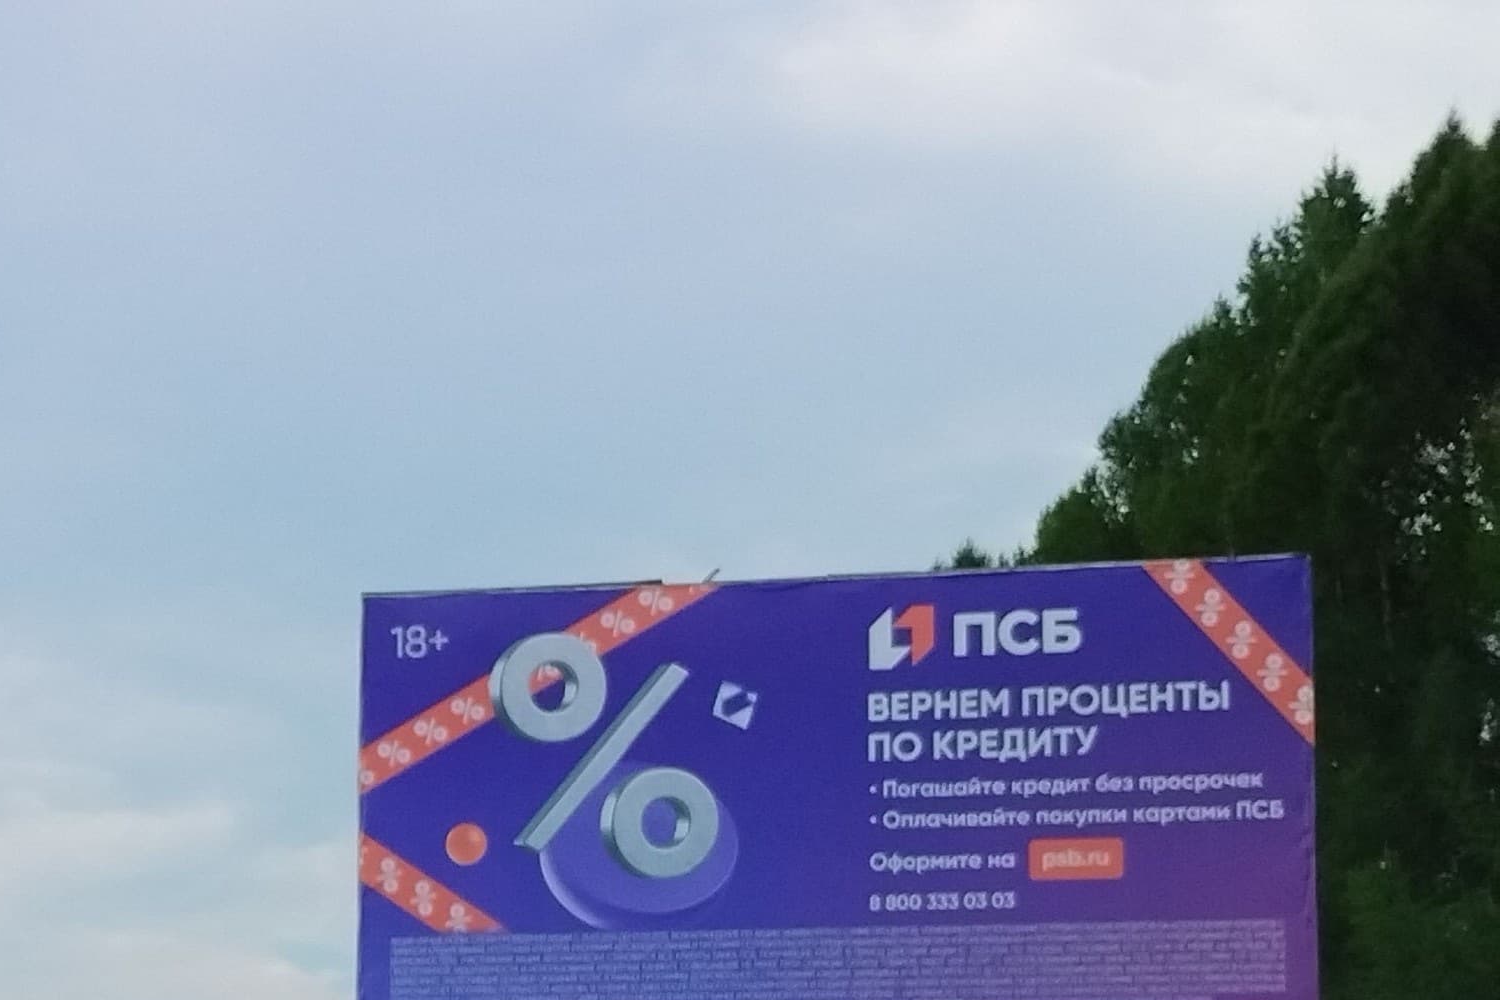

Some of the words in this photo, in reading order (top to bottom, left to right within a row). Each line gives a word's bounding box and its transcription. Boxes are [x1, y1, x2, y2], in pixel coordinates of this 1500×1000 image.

[390, 625, 449, 659] 18+
[953, 607, 1083, 657] ПСБ
[867, 688, 1011, 722] ВЕРНЕМ
[1021, 679, 1230, 718] ПРОЦЕНТЫ
[867, 731, 923, 763] ПО
[932, 725, 1099, 763] КРЕДИТУ
[882, 777, 1007, 798] Погашайте
[1011, 778, 1090, 798] кредит
[1095, 773, 1134, 792] без
[1139, 772, 1264, 794] просрочек
[882, 807, 1030, 829] Оплачивайте
[1036, 808, 1127, 829] покупки
[1133, 804, 1231, 827] картами
[1235, 799, 1285, 819] ПСБ
[869, 851, 982, 875] Оформите
[987, 854, 1016, 869] на
[1042, 850, 1110, 872] psb.ru
[869, 894, 881, 912] 8
[885, 892, 921, 911] 800
[926, 892, 960, 911] 333
[963, 892, 987, 910] 03
[991, 891, 1015, 909] 03
